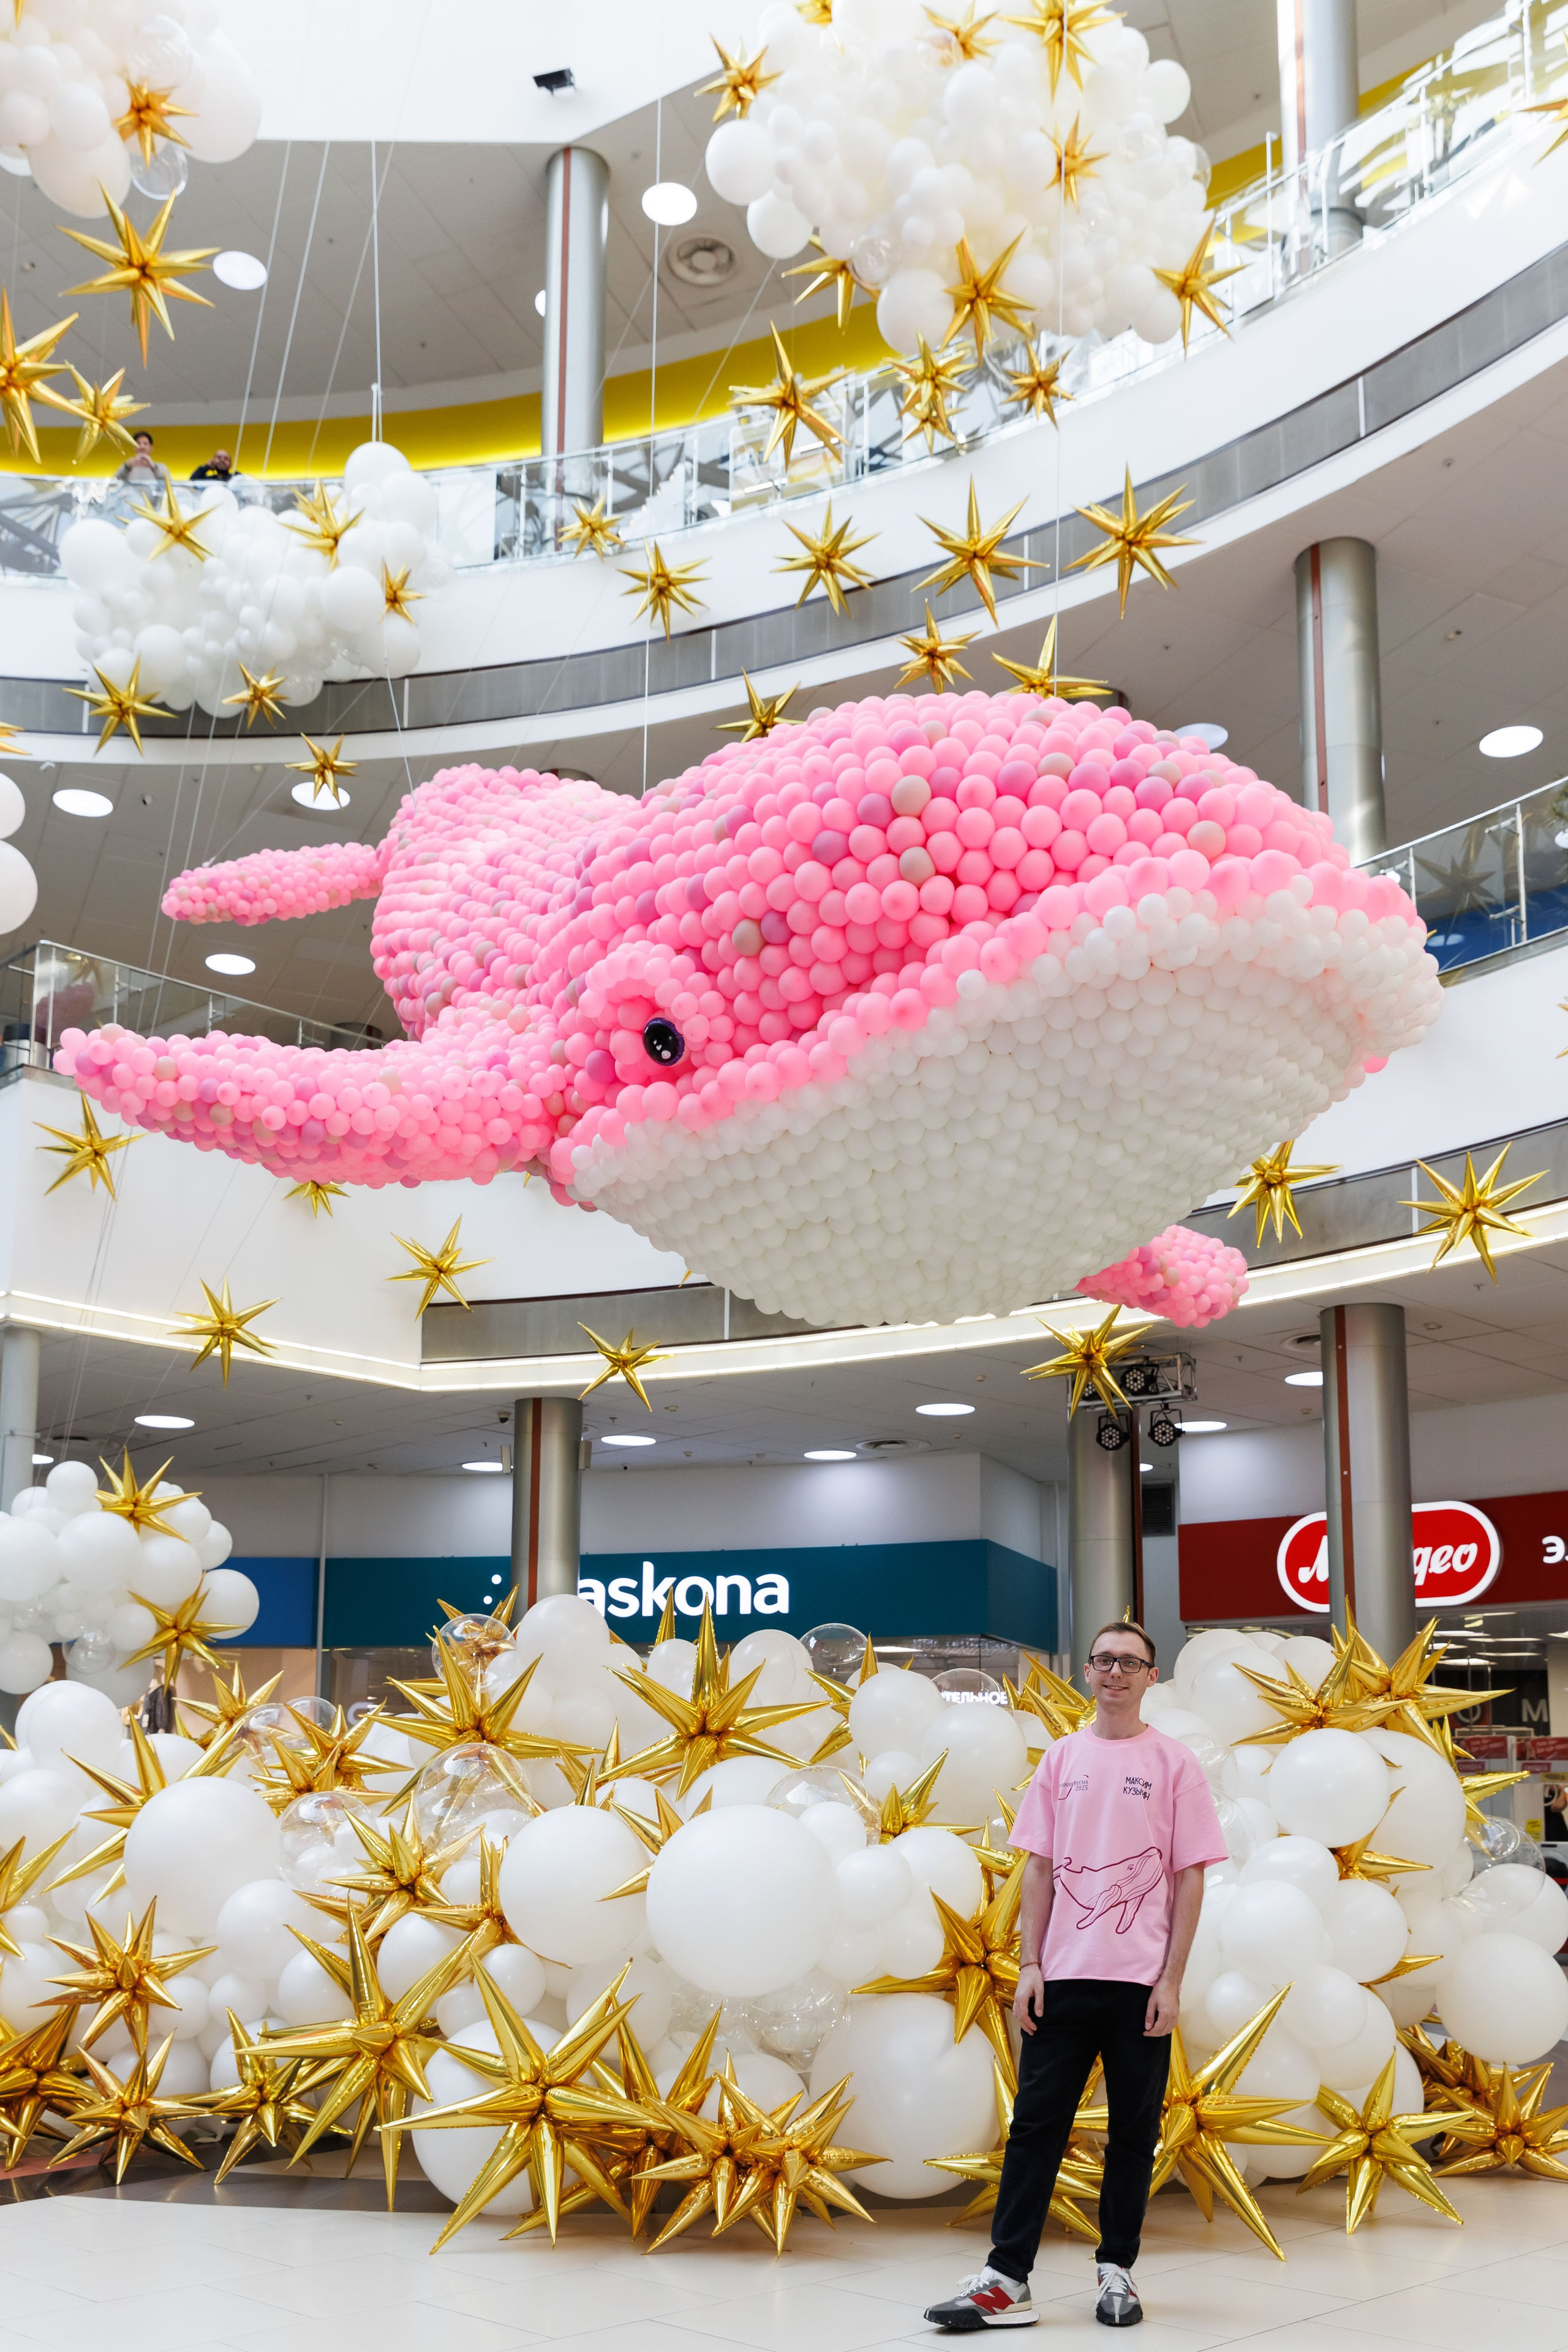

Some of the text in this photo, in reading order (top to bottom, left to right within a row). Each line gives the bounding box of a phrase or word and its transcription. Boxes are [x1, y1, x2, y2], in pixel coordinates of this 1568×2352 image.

[1542, 1535, 1568, 1564] Э
[578, 1561, 789, 1618] askona
[941, 1691, 1009, 1705] ТЕЛЬНОЕ
[1125, 1776, 1152, 1790] МАКСИМ
